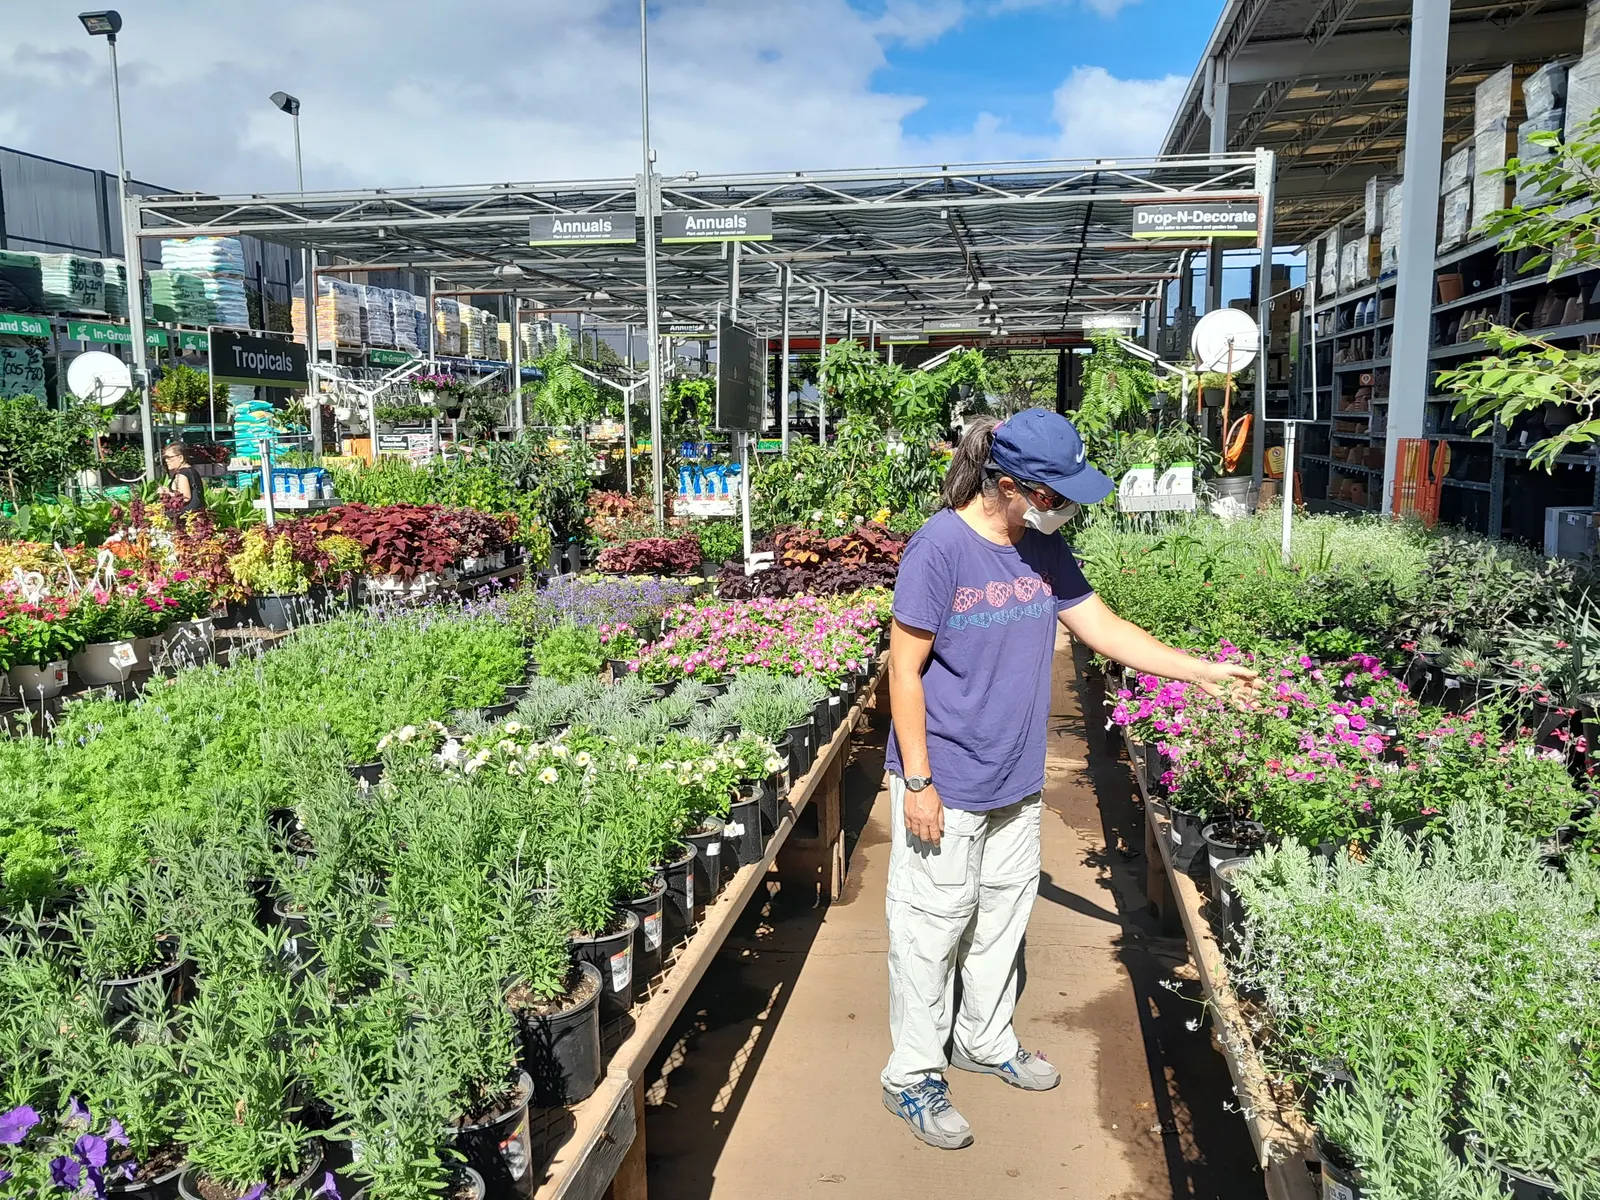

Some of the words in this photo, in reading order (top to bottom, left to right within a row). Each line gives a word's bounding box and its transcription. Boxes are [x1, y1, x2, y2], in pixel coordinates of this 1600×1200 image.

[684, 214, 747, 230] Annuals
[1138, 210, 1256, 225] Drop-N-Decorate
[552, 218, 612, 233] Annuals
[21, 321, 42, 333] Soil
[94, 328, 132, 342] In-Grou
[232, 345, 293, 374] Tropicals
